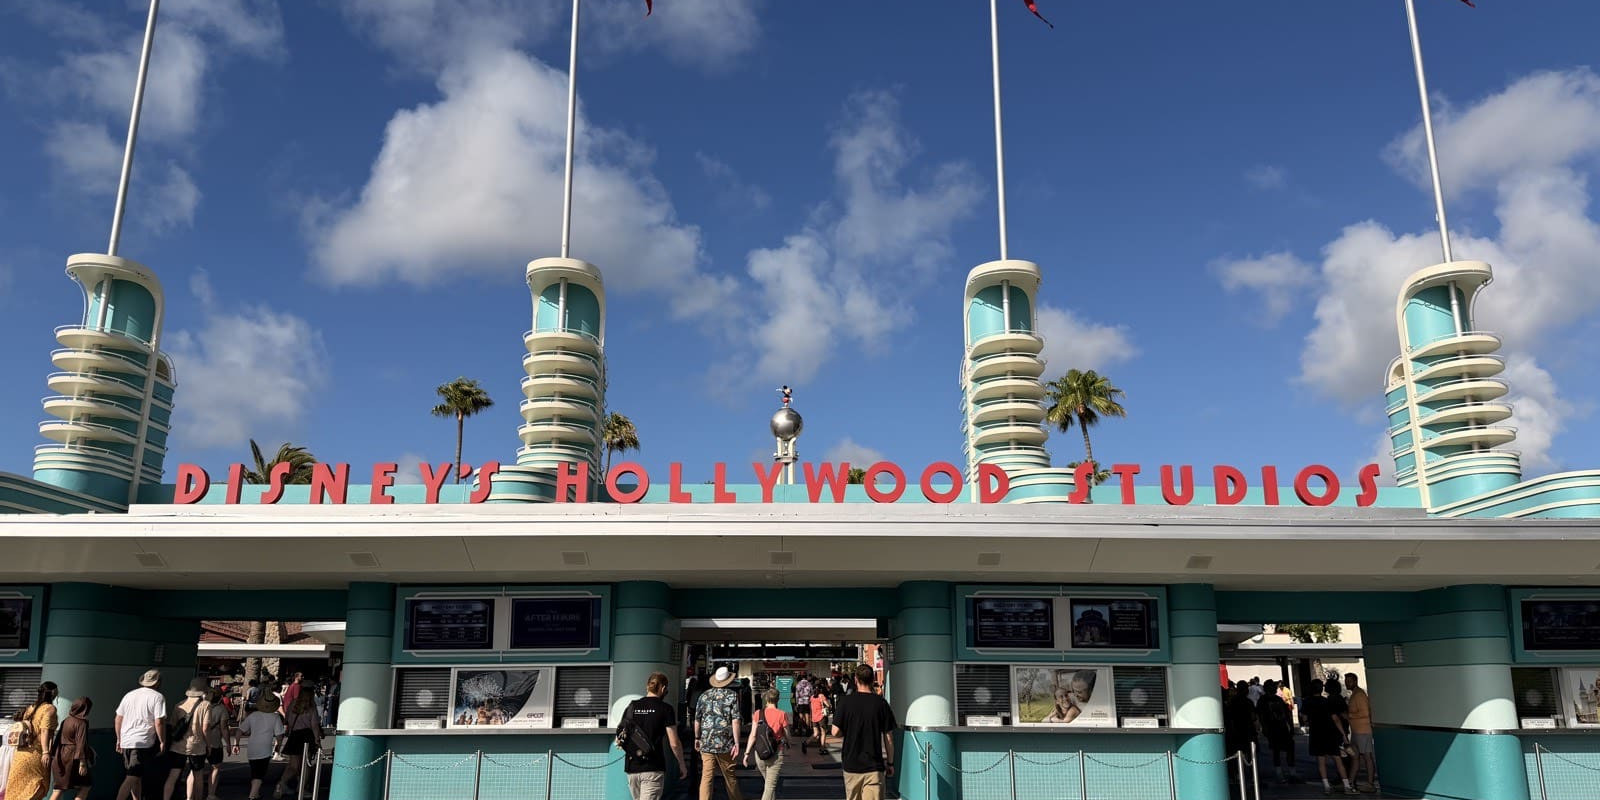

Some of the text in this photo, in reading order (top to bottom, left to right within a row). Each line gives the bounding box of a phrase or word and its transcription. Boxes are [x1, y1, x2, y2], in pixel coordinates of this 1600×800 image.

[173, 460, 1382, 508] DISNEY'S HOLLYWOOD STUDIOS
